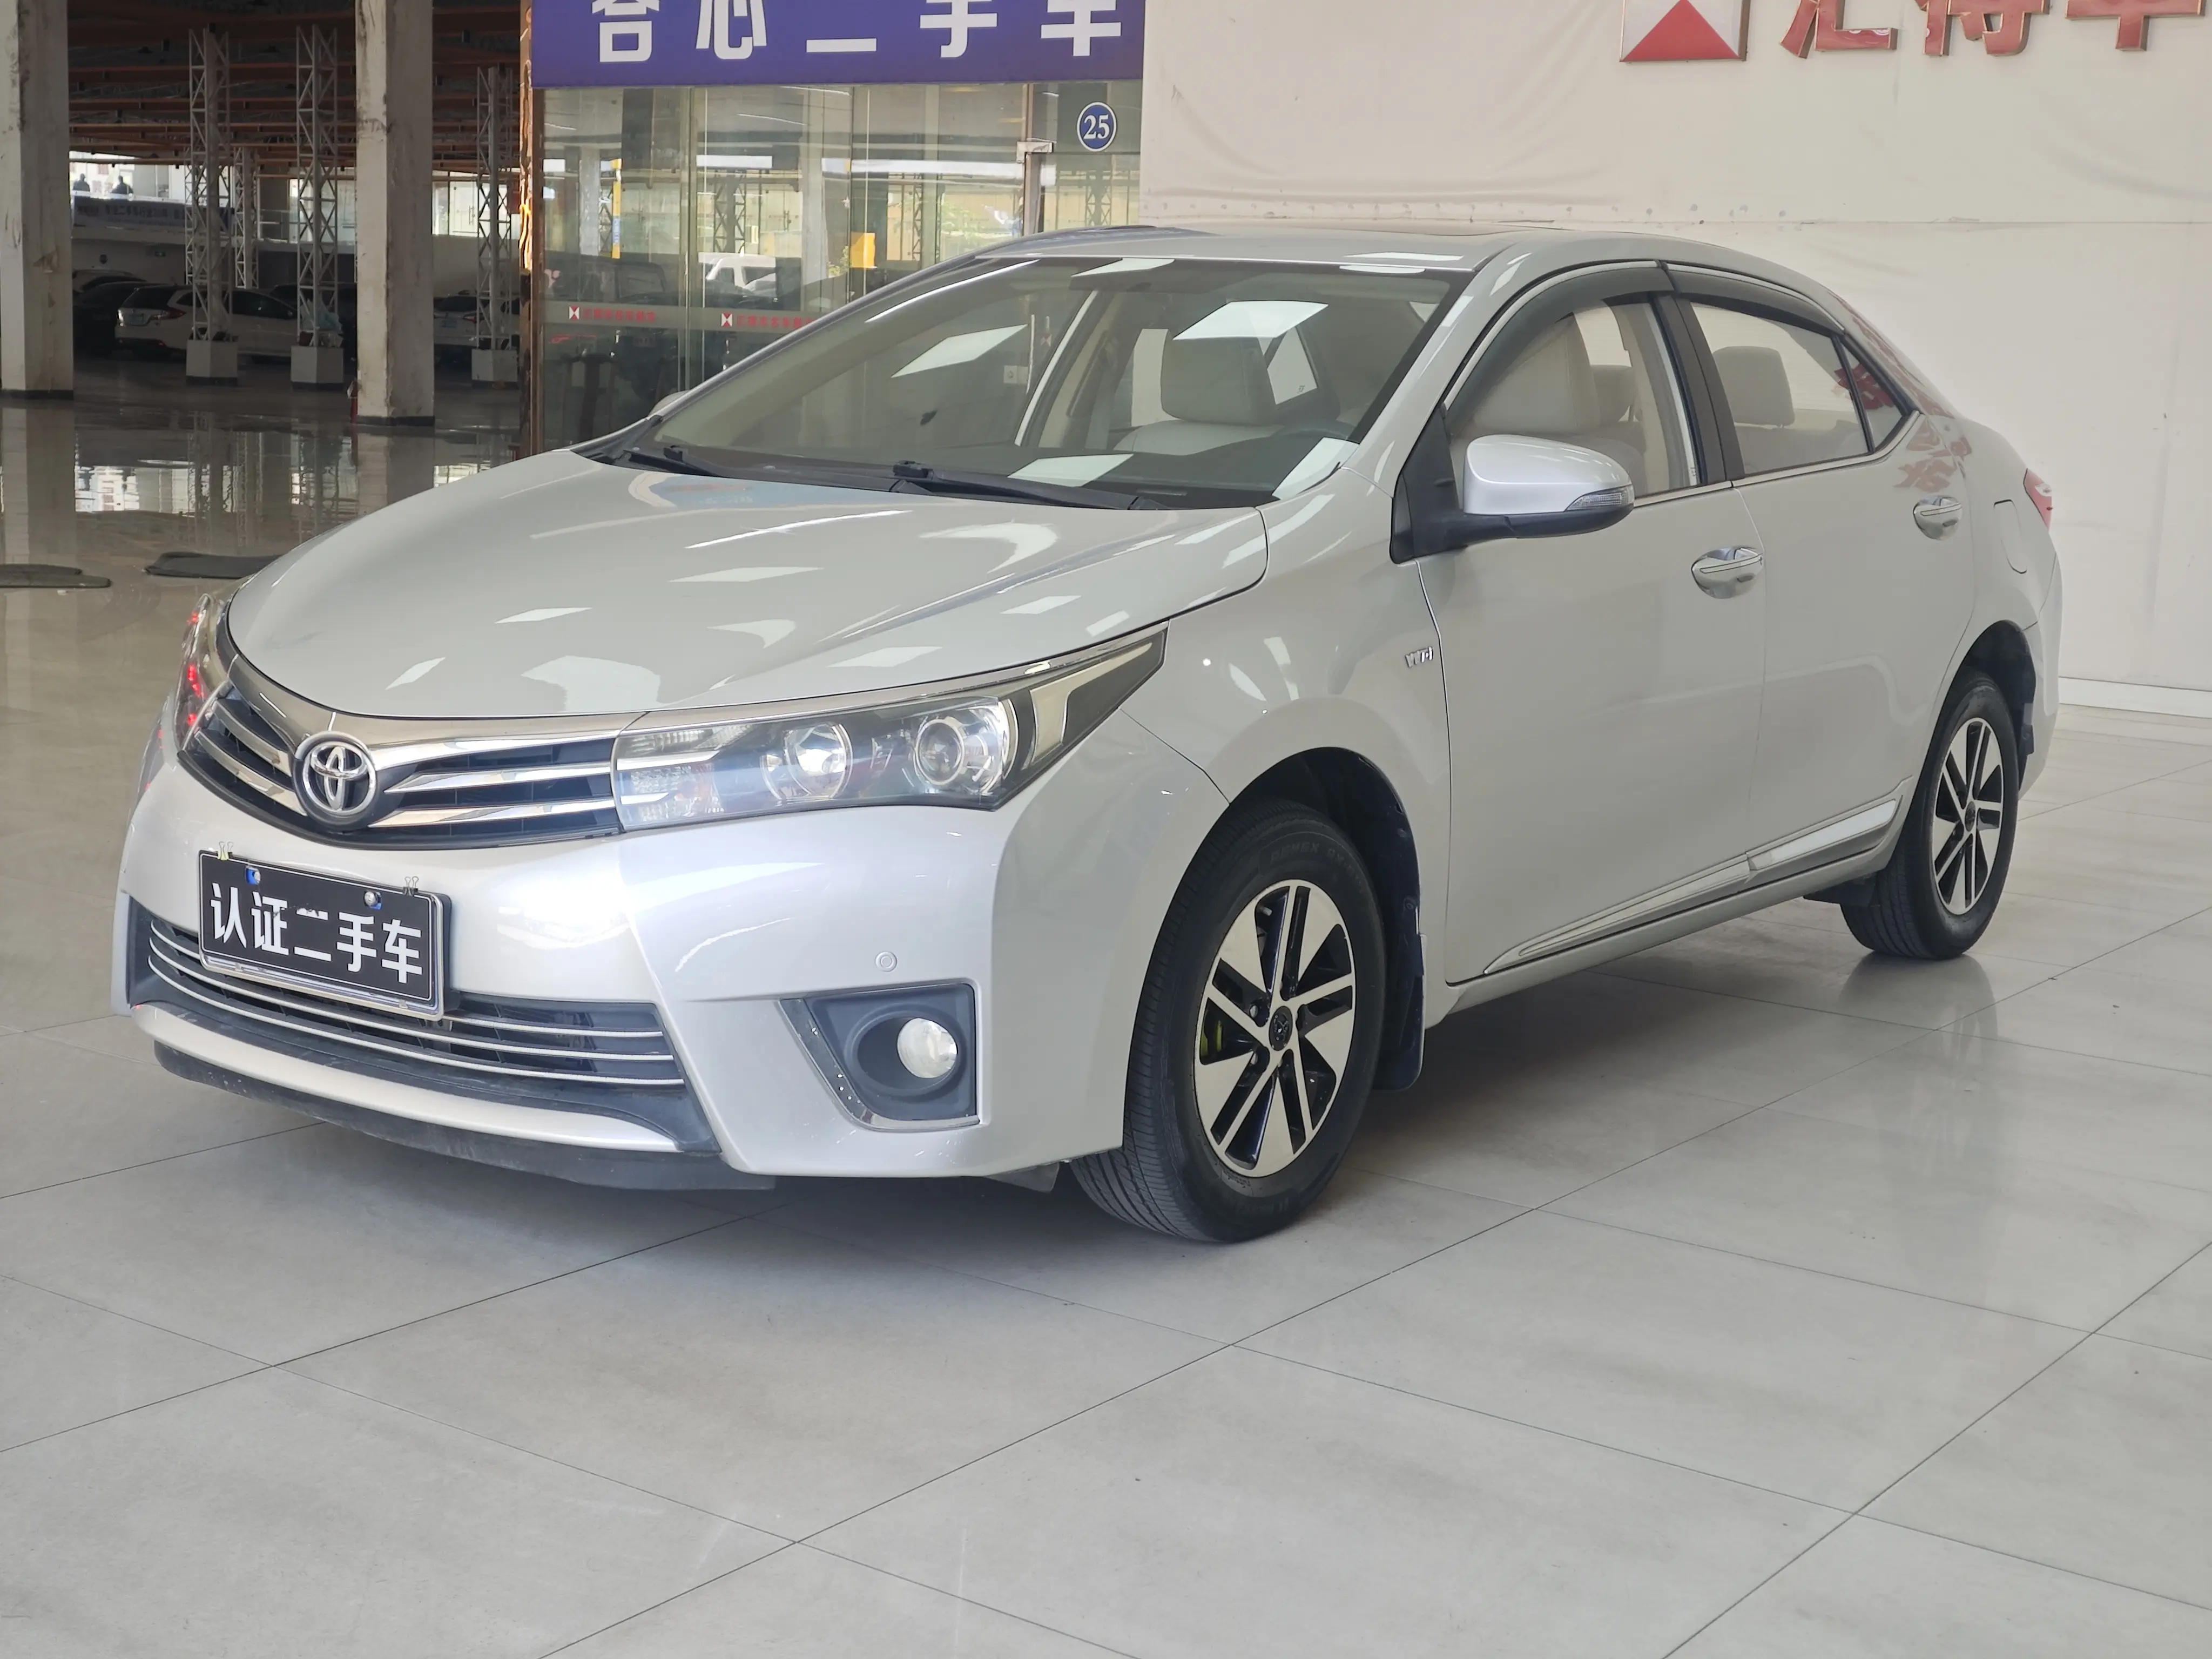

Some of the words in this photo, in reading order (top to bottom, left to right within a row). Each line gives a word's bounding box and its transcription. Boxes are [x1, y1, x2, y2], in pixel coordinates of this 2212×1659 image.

[1083, 114, 1110, 139] 25
[210, 882, 423, 984] 认证二手车
